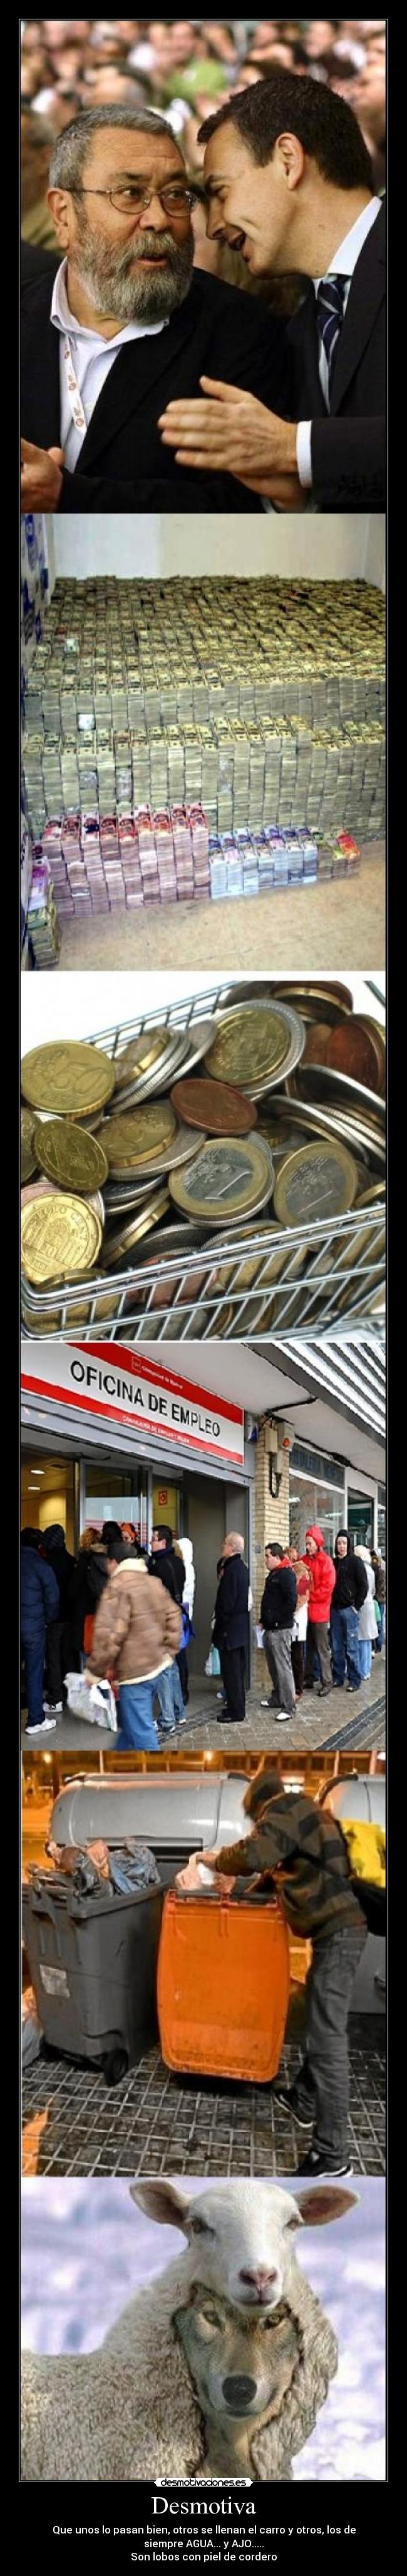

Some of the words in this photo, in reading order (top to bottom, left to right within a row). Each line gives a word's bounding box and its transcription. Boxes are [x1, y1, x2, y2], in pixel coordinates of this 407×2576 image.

[70, 1360, 145, 1407] OFICINA
[148, 1393, 168, 1416] DE
[172, 1403, 220, 1437] EMPLEO
